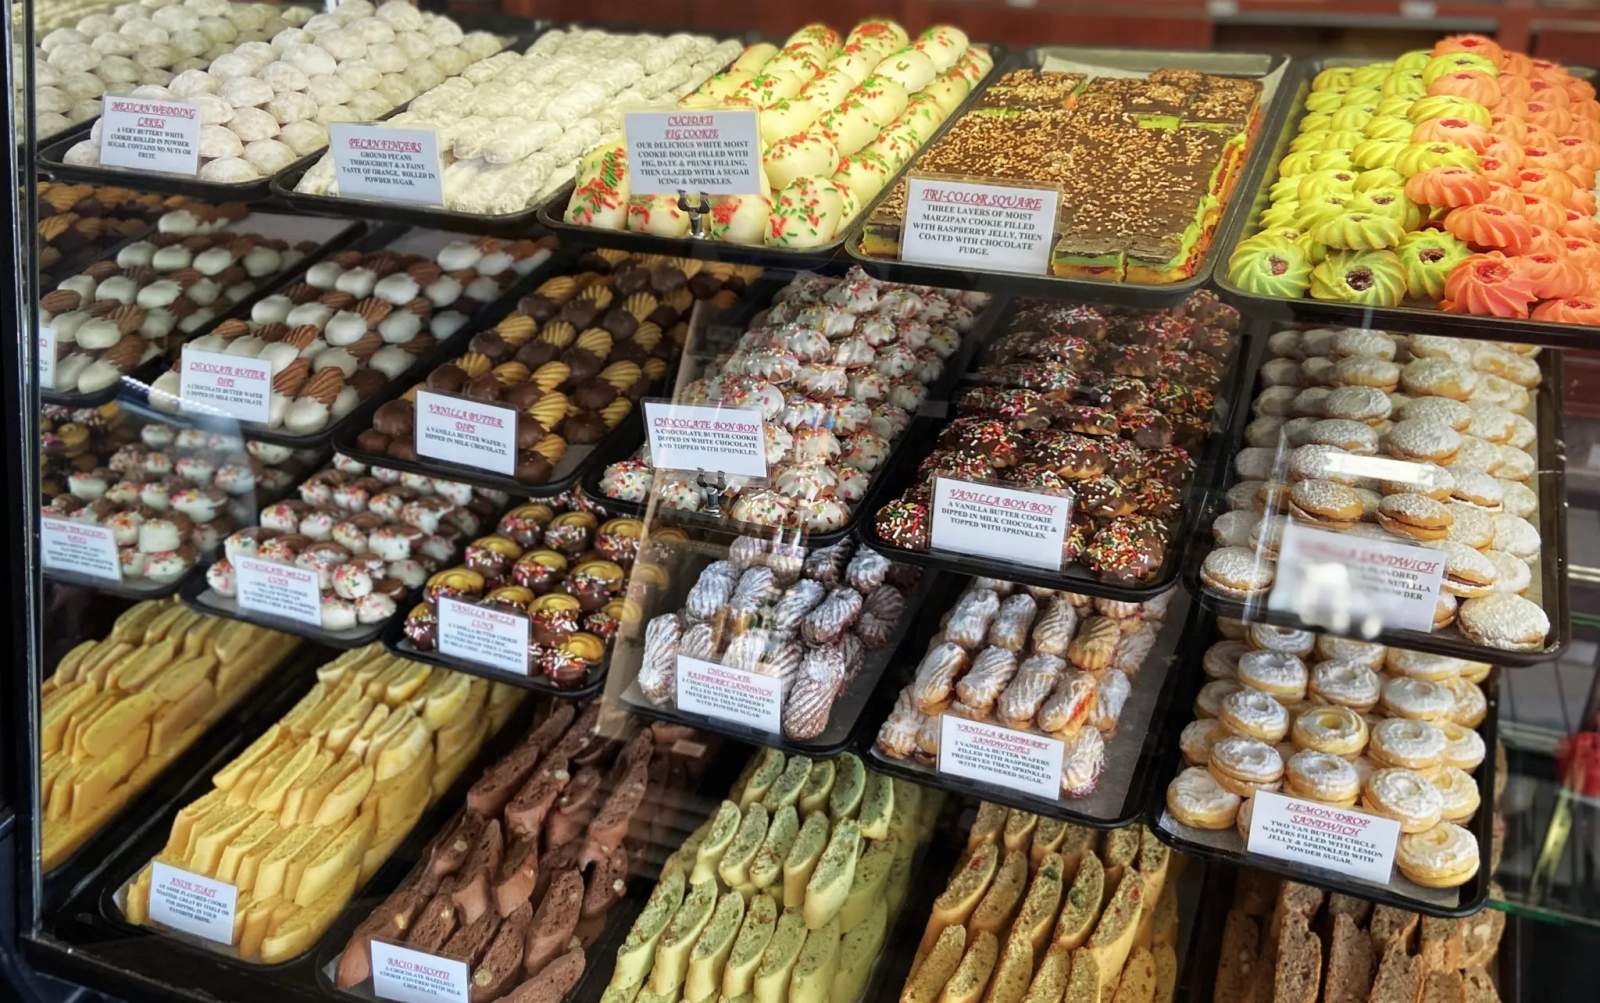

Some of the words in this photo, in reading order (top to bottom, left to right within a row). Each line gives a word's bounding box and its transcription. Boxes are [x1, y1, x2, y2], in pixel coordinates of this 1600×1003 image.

[684, 129, 720, 139] COOKIE
[164, 139, 189, 147] POWDER
[349, 137, 380, 149] PECAN
[383, 140, 422, 153] FINGERS
[349, 159, 393, 168] THROUGHOUT
[922, 189, 989, 206] TRI-COLOR
[990, 195, 1043, 211] SQUARE
[927, 204, 955, 213] THREE
[957, 207, 990, 216] LAYERS
[1005, 211, 1033, 220] MOIST
[922, 214, 967, 223] MARZIPAN
[969, 218, 1001, 227] COOKIE
[1004, 221, 1035, 230] FILLED
[913, 223, 935, 231] WITH
[937, 225, 986, 235] RASPBERRY
[988, 229, 1017, 239] JELLY,
[1019, 233, 1042, 241] THEN
[919, 233, 954, 242] COATED
[955, 236, 978, 245] WITH
[980, 238, 1033, 250] CHOCOLATE
[959, 247, 989, 256] FUDGE.
[655, 417, 712, 430] CHOCOLATE
[714, 421, 736, 431] BON
[737, 423, 760, 433] BON
[715, 440, 757, 448] CHOCOLATE
[949, 488, 999, 506] VANILLA
[1002, 497, 1029, 510] BON
[1029, 502, 1056, 515] BON
[942, 508, 968, 517] DIPPED
[980, 514, 999, 523] MILK
[1000, 518, 1049, 532] CHOCOLATE
[955, 503, 987, 514] VANILLA
[989, 508, 1019, 518] BUTTER
[1021, 513, 1053, 523] COOKIE
[950, 517, 979, 527] TOPPED
[981, 523, 1001, 532] WITH
[958, 748, 983, 757] FILLED
[985, 753, 1003, 761] WITH
[1004, 757, 1045, 771] RASPBERRY
[960, 742, 990, 752] VANILLA
[992, 748, 1019, 759] BUTTER
[1021, 754, 1050, 766] WAFERS
[952, 753, 991, 765] PRESERVES
[992, 761, 1010, 769] THEN
[1012, 765, 1051, 780] SPRINKLED
[978, 765, 1017, 777] POWDERED
[1285, 803, 1333, 819] LEMON
[1334, 813, 1371, 828] DROP
[1290, 814, 1361, 837] SANDWICH
[1263, 826, 1295, 836] WAFERS
[1297, 832, 1326, 843] FILLED
[1328, 839, 1351, 850] WITH
[1353, 845, 1383, 857] LEMON
[1271, 821, 1290, 829] TWO
[1292, 824, 1308, 832] VAN
[1311, 828, 1343, 840] BUTTER
[1345, 837, 1376, 849] CIRCLE
[1268, 834, 1292, 844] JELLY
[1304, 842, 1350, 857] SPRINKLED
[1352, 853, 1375, 863] WITH
[1286, 845, 1321, 857] POWDER
